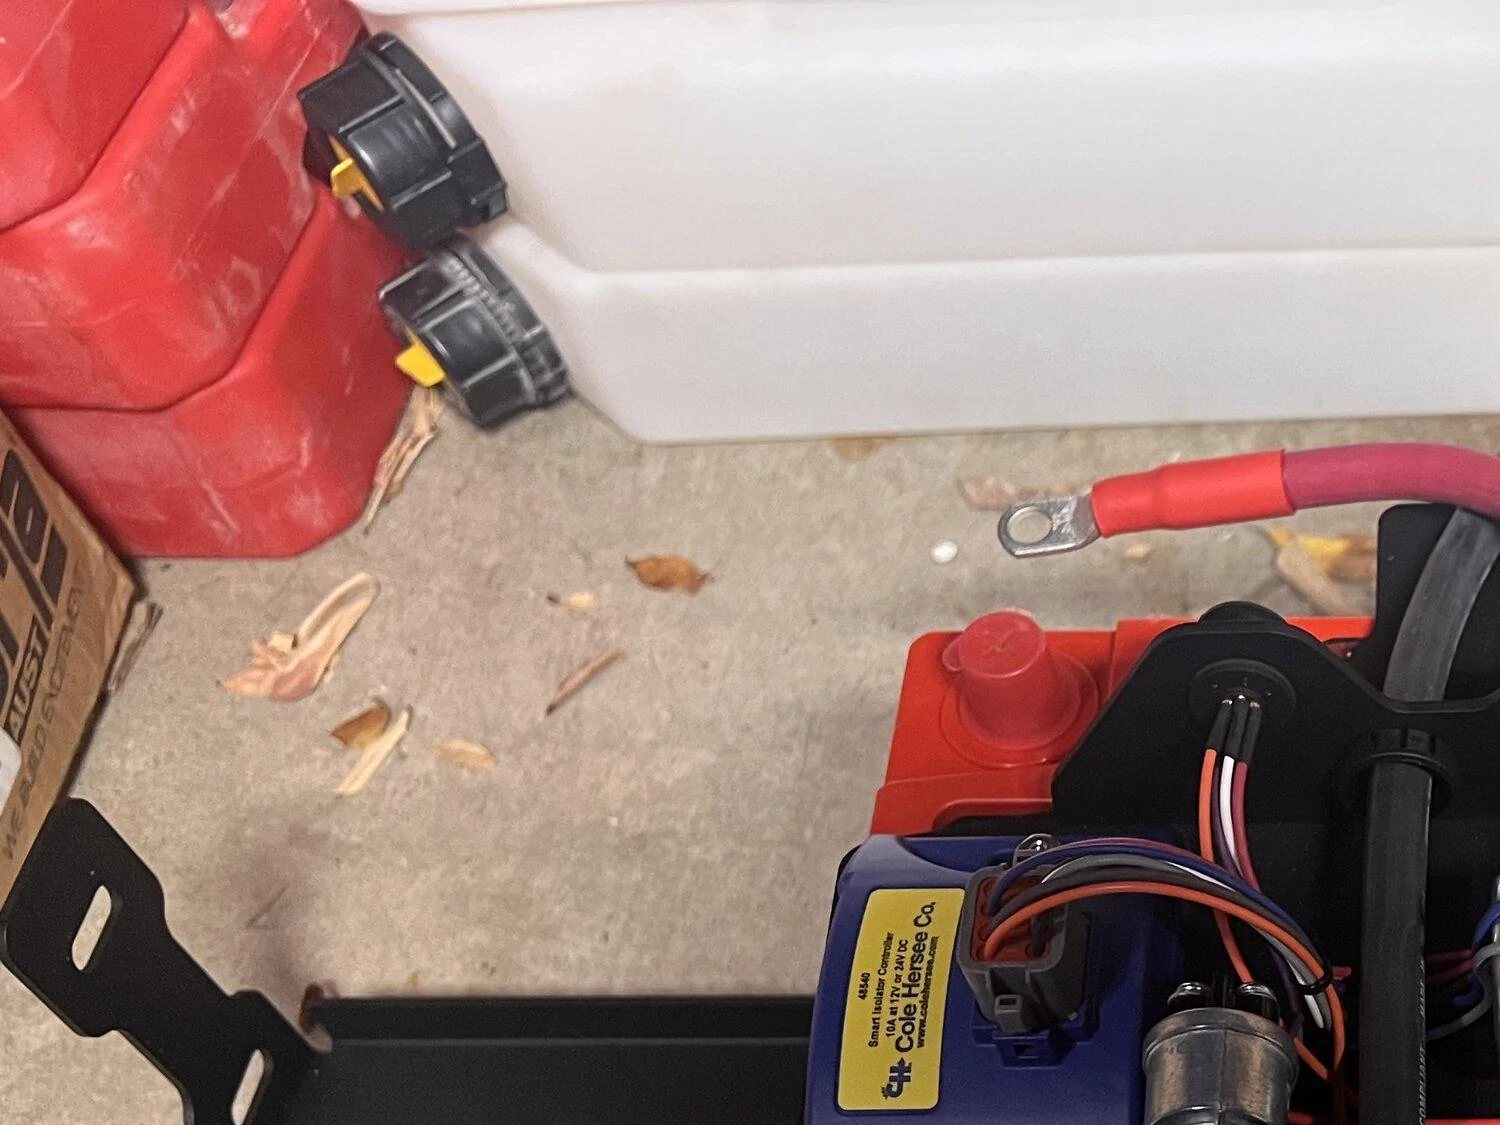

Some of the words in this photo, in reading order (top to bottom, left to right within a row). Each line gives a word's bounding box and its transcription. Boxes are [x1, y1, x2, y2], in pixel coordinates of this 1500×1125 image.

[913, 901, 937, 928] Co.
[877, 931, 895, 976] Controller
[898, 939, 909, 953] DC
[894, 951, 905, 973] 24V
[902, 931, 929, 999] Hersee
[857, 971, 871, 1001] 48540
[893, 974, 902, 985] or
[916, 935, 940, 1049] www.colehersee.com
[873, 978, 885, 1013] Isolator
[889, 986, 901, 1005] 12V
[889, 1005, 898, 1018] at
[868, 1016, 879, 1048] Smart
[885, 1018, 897, 1038] 10A
[895, 1003, 918, 1053] Cole
